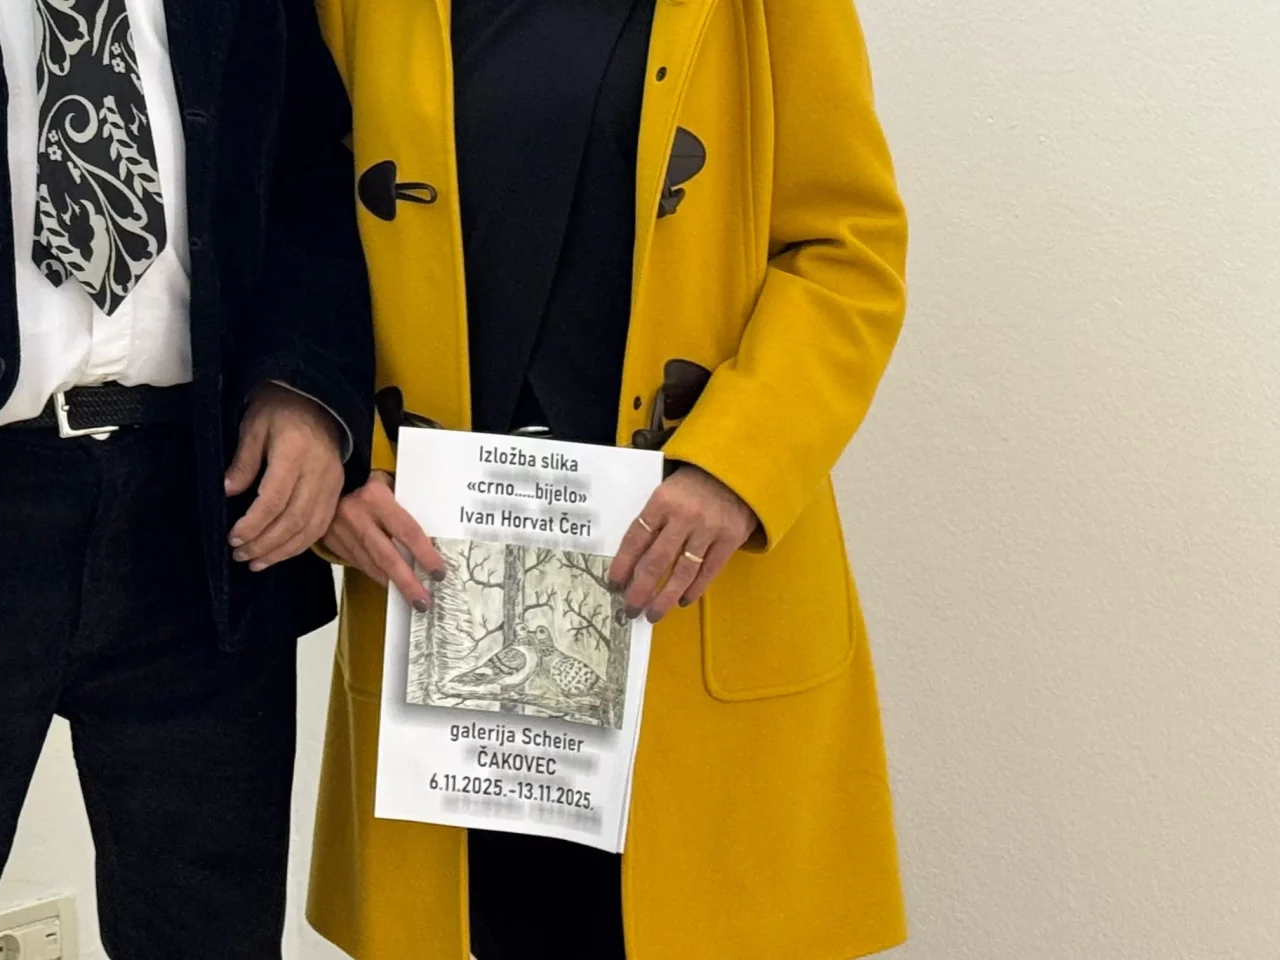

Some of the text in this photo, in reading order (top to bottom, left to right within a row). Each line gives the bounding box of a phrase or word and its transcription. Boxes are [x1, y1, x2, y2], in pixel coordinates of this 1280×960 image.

[479, 445, 579, 472] Izložba slika
[459, 506, 592, 537] Ivan Horvat Čeri
[450, 722, 584, 753] galerija Scheier
[477, 746, 557, 775] ČAKOVEC
